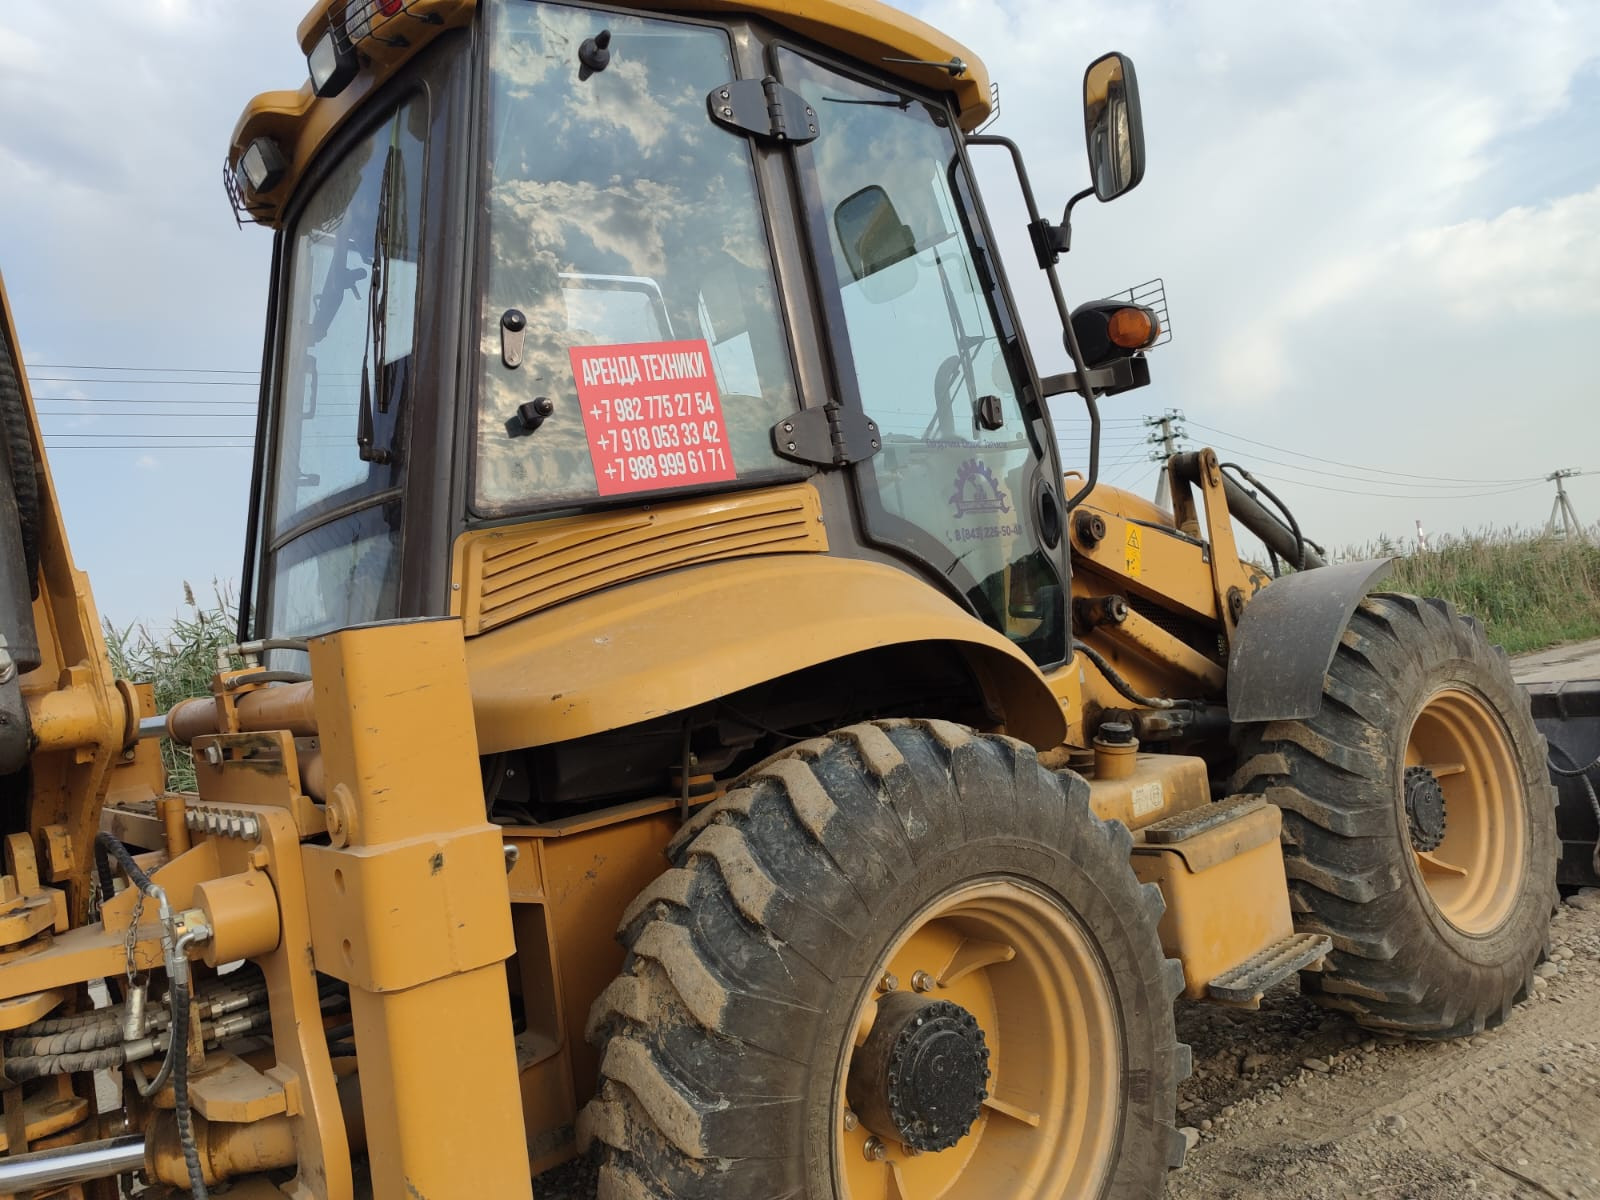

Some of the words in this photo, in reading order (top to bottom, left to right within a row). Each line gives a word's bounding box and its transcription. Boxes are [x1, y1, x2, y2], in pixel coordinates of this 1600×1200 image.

[582, 355, 641, 386] АРЕНДА
[640, 352, 707, 381] ТЕХНИКИ
[590, 400, 611, 423] +7
[614, 397, 644, 422] 982
[644, 395, 673, 419] 775
[674, 393, 691, 417] 27
[695, 392, 714, 415] 54
[597, 430, 618, 453] +7
[621, 426, 651, 452] 918
[651, 424, 680, 449] 053
[680, 422, 700, 446] 33
[702, 420, 721, 443] 42
[604, 458, 625, 482] +7
[628, 455, 658, 480] 988
[658, 452, 687, 477] 999
[687, 450, 706, 473] 61
[707, 448, 726, 471] 71
